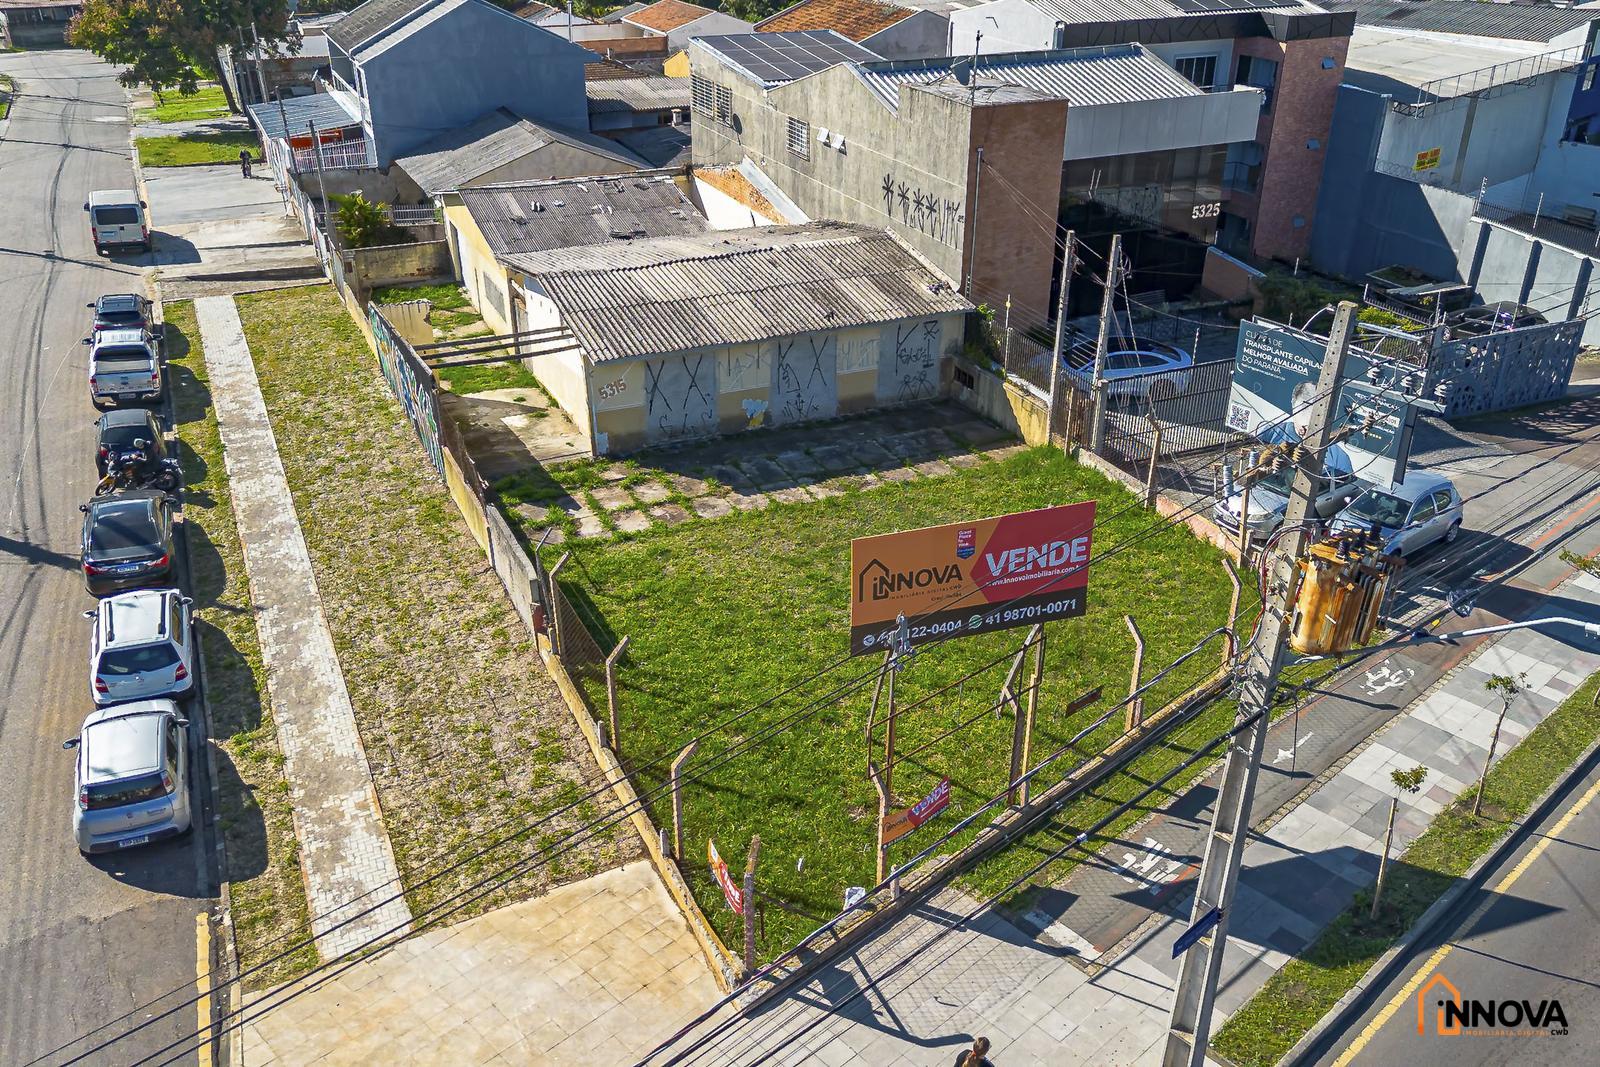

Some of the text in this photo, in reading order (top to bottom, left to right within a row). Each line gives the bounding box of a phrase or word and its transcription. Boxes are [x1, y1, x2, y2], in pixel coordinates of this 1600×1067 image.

[1192, 203, 1221, 219] 5325
[1244, 338, 1294, 360] TRANSPLANTE
[1272, 338, 1283, 348] DE
[1242, 355, 1253, 364] DO
[1243, 346, 1273, 362] MELHOR
[1272, 357, 1309, 375] AVALIADA
[599, 379, 627, 400] 5315
[985, 536, 1088, 577] VENDE
[899, 619, 962, 639] 122-0404
[986, 611, 1001, 625] 41
[1003, 598, 1077, 622] 98701-0071
